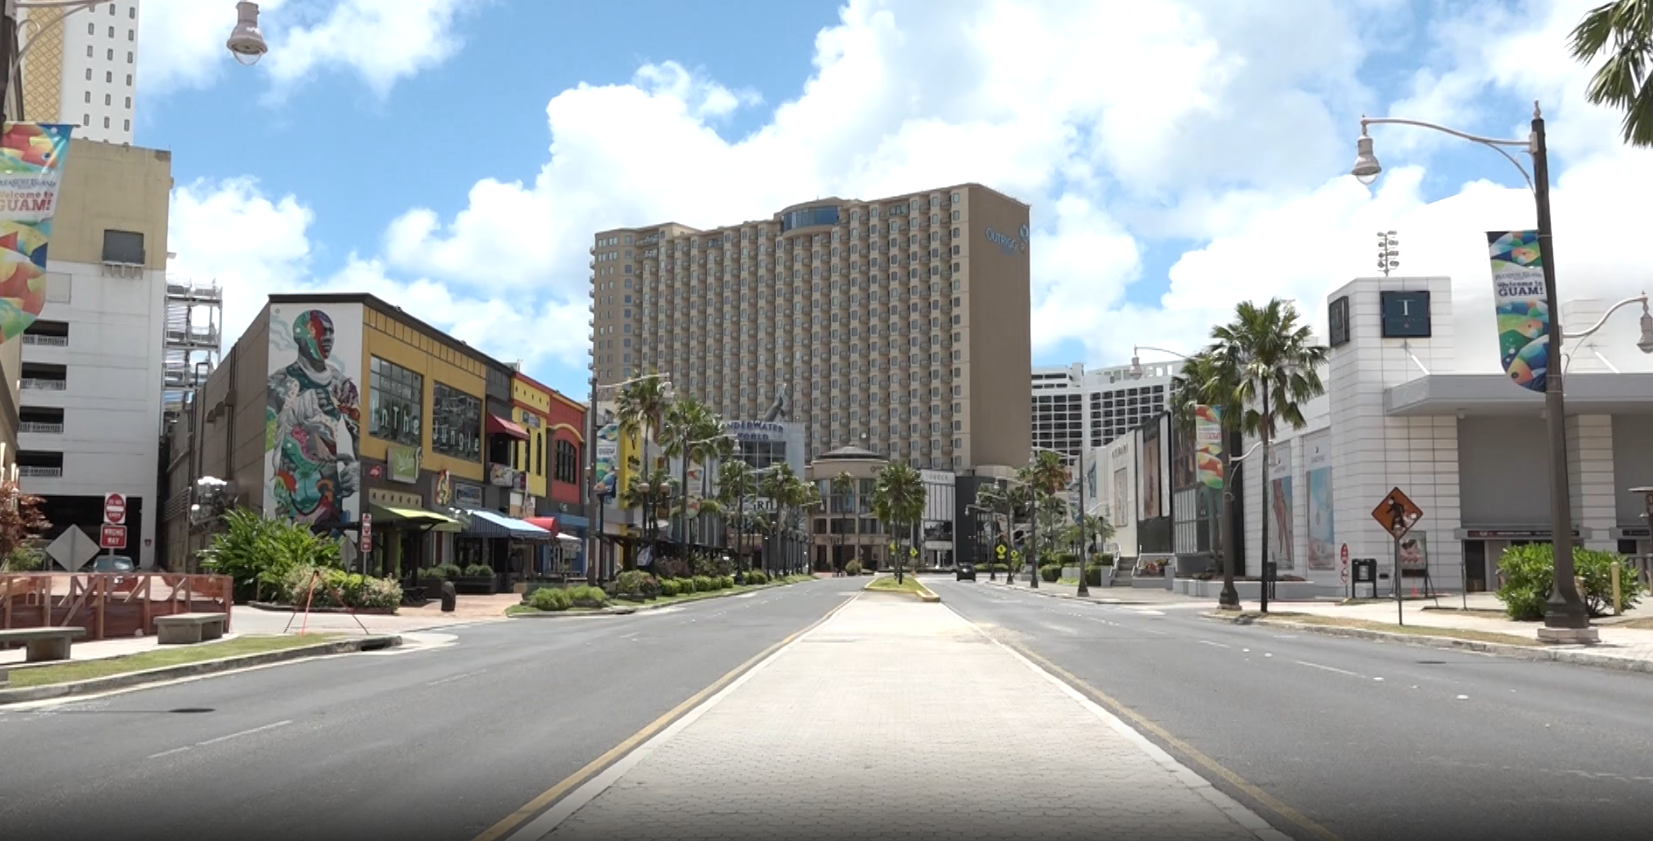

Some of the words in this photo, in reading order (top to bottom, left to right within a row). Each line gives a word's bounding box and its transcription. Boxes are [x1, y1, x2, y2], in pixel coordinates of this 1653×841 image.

[1498, 286, 1544, 297] GUAM!
[727, 421, 784, 434] NDERWATER
[432, 420, 480, 452] Jungle
[104, 528, 124, 536] WRONG
[107, 537, 120, 545] WAY
